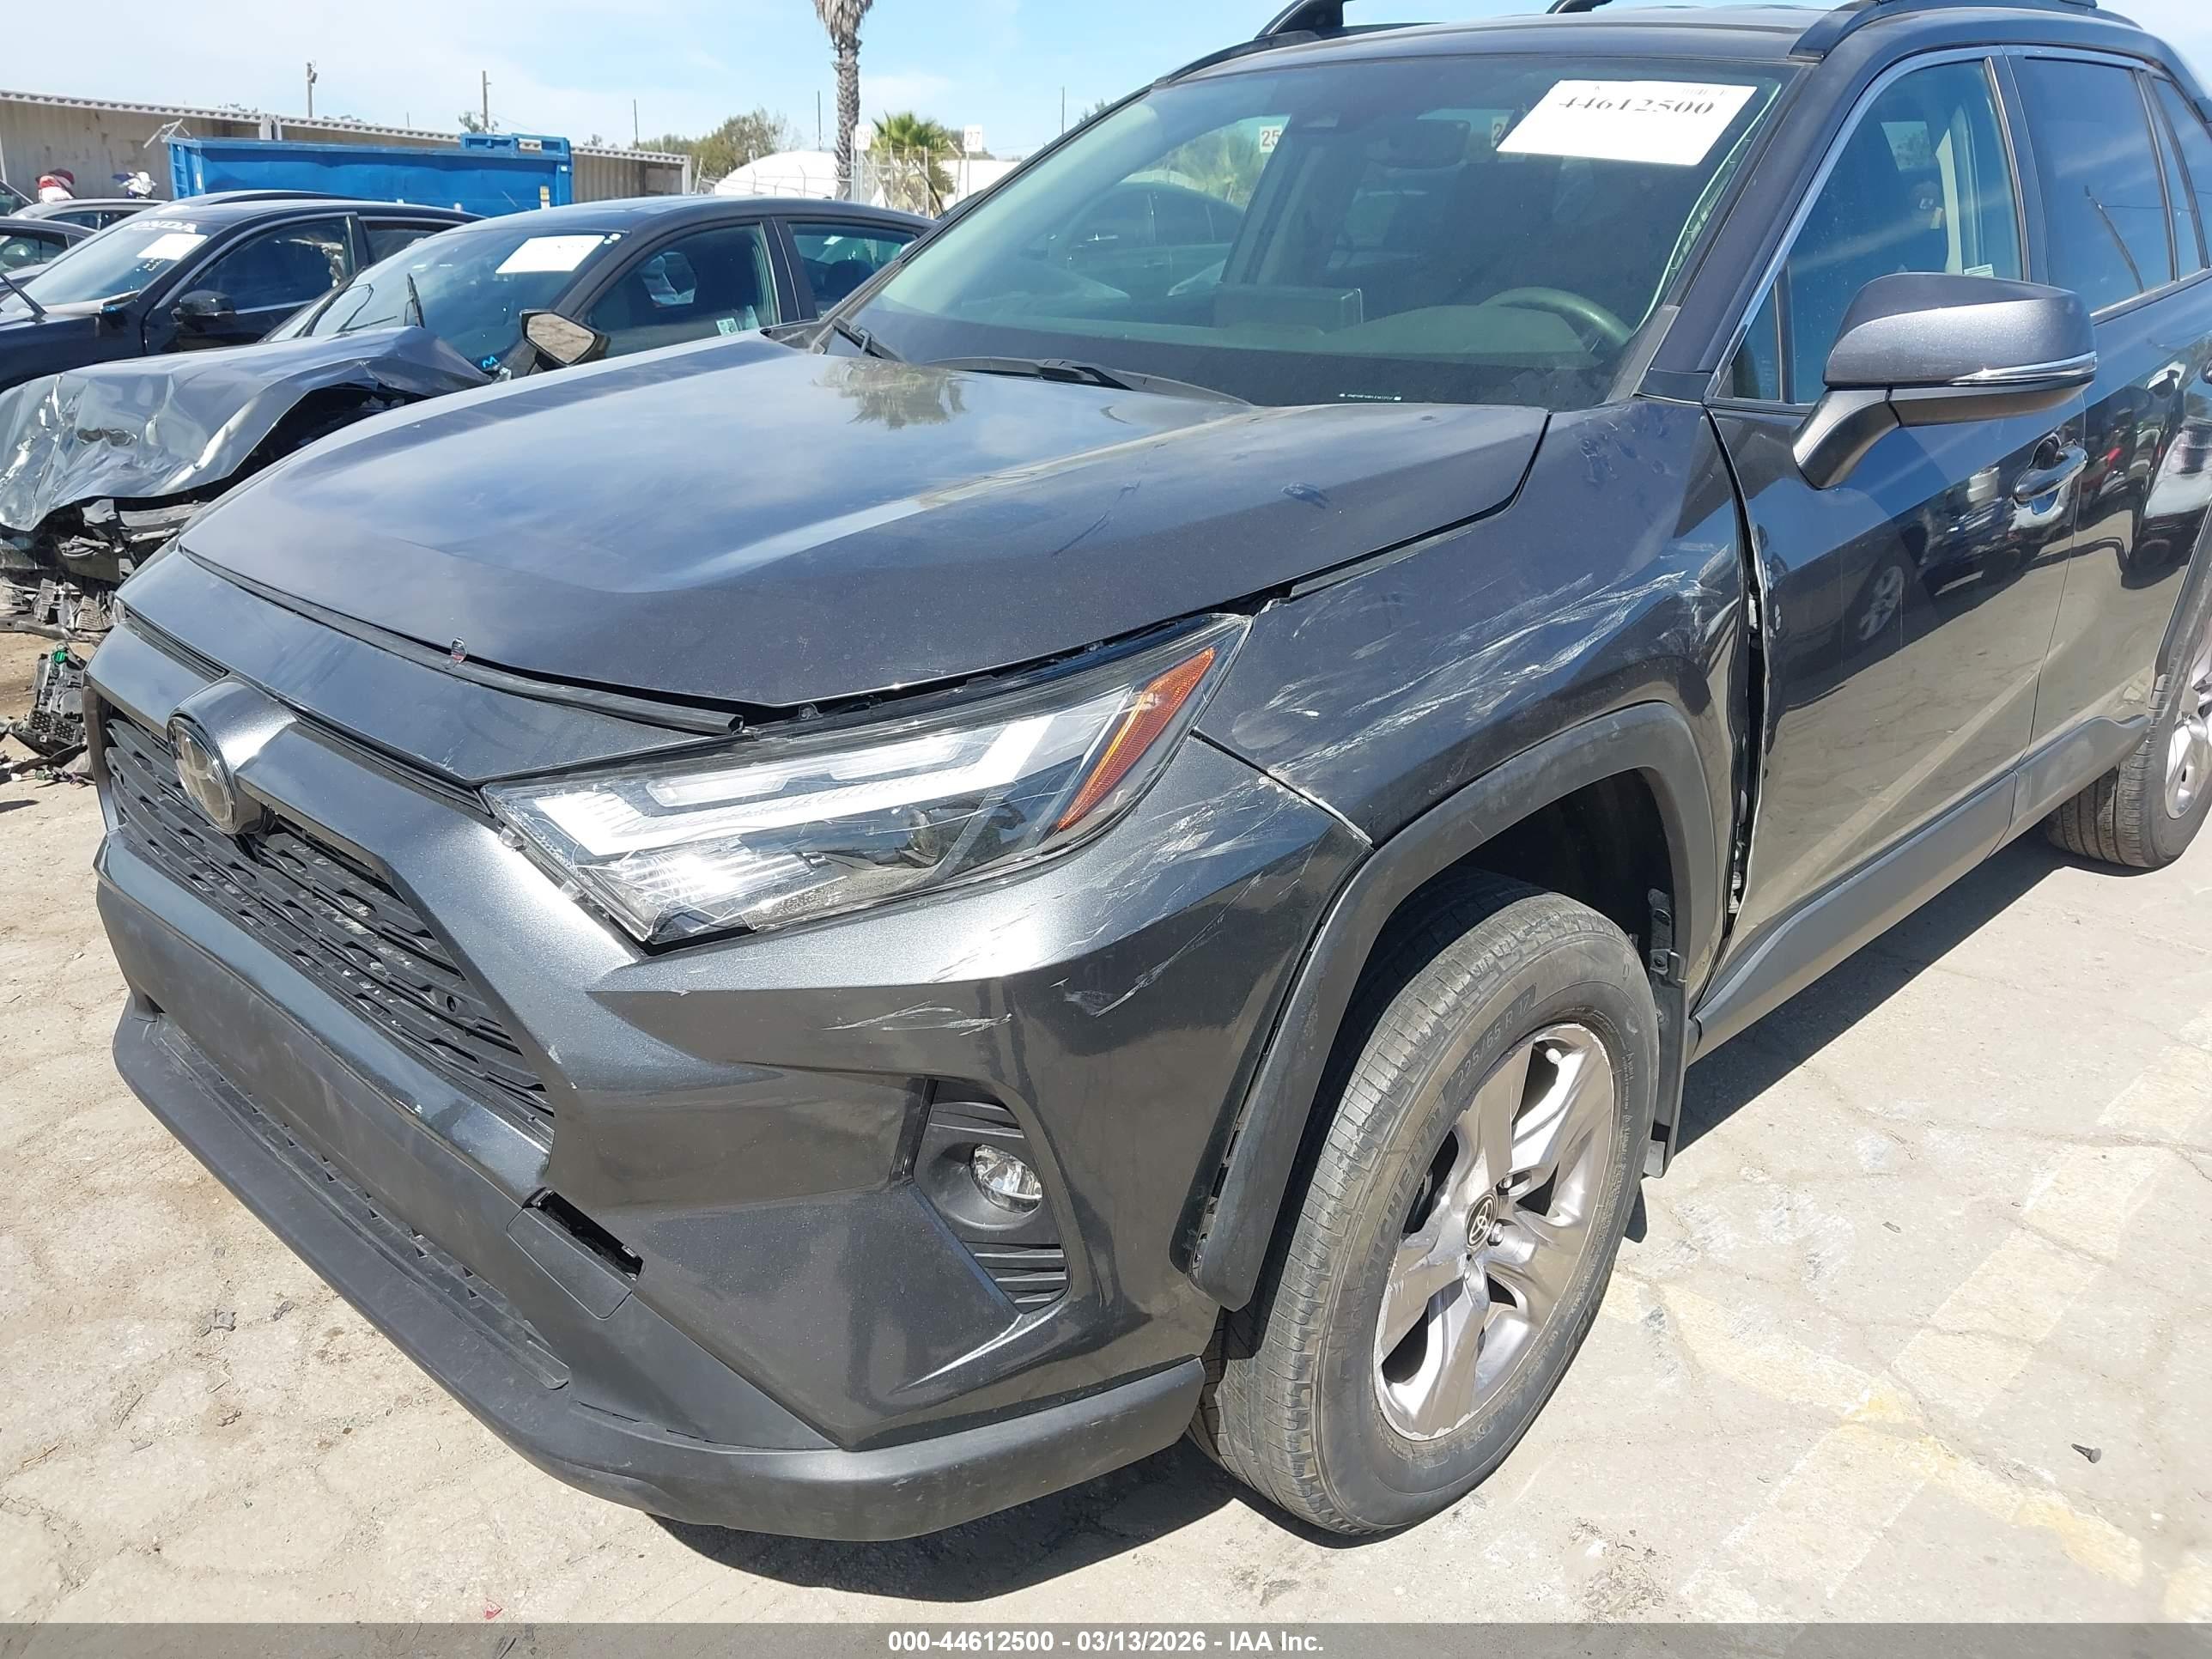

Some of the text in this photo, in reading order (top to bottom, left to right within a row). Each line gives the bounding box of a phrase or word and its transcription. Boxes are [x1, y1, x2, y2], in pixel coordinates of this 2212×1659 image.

[1559, 96, 1715, 114] 44612500
[966, 131, 981, 146] 27
[1261, 130, 1280, 147] 25
